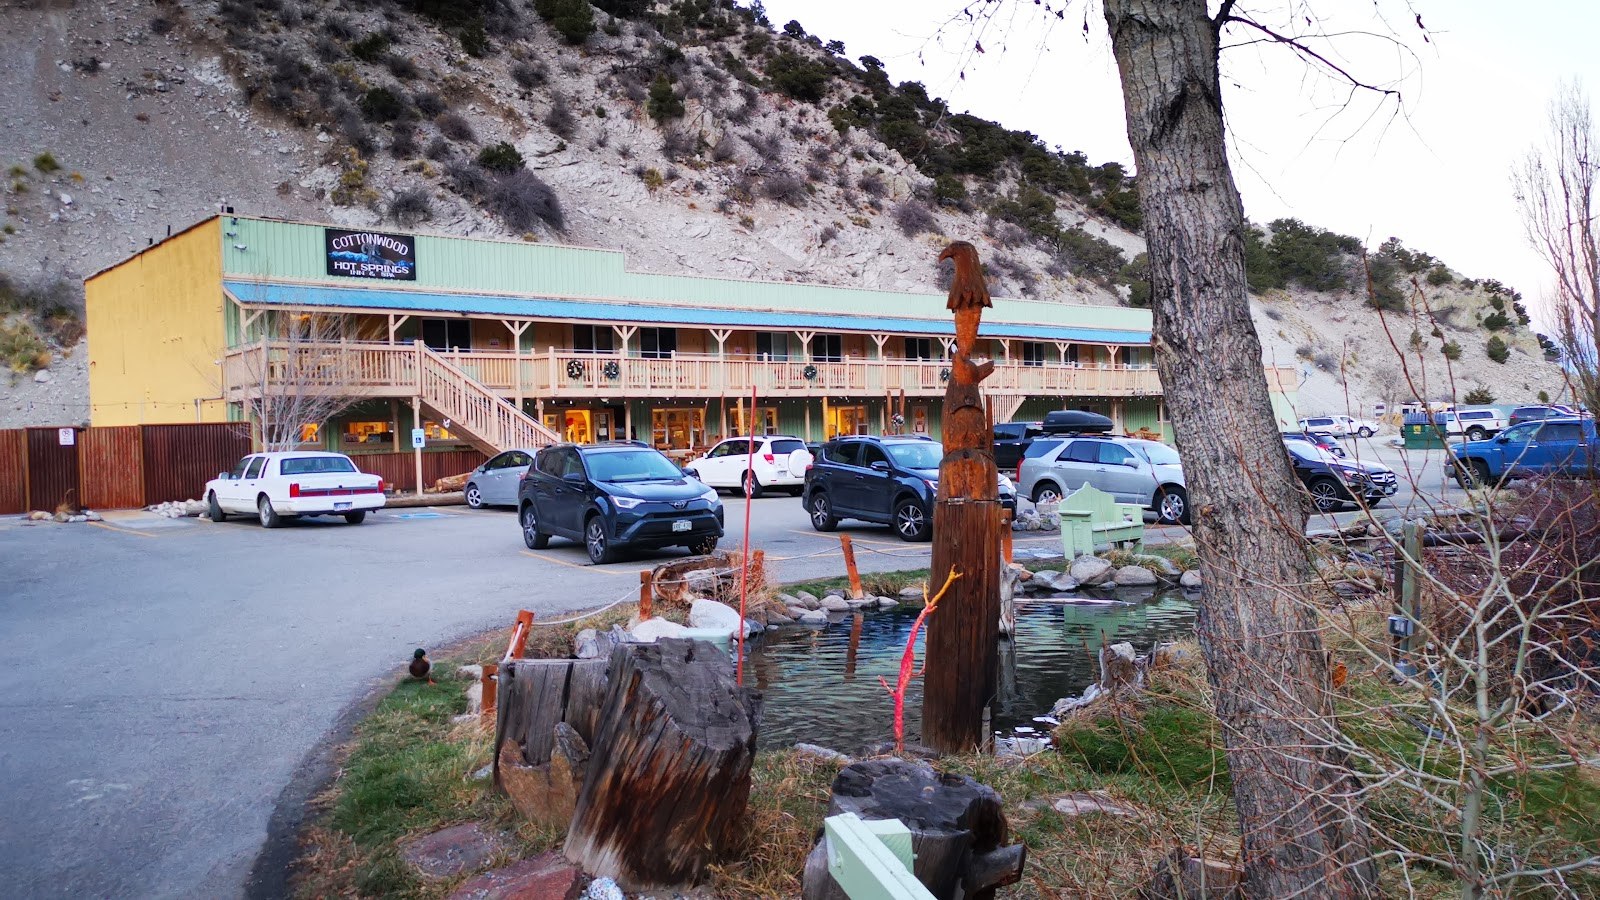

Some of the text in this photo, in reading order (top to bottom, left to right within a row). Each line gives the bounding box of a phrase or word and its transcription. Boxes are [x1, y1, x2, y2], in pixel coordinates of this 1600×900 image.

[333, 233, 408, 255] COTTONWOOD
[334, 261, 409, 274] HOT SPRINGS
